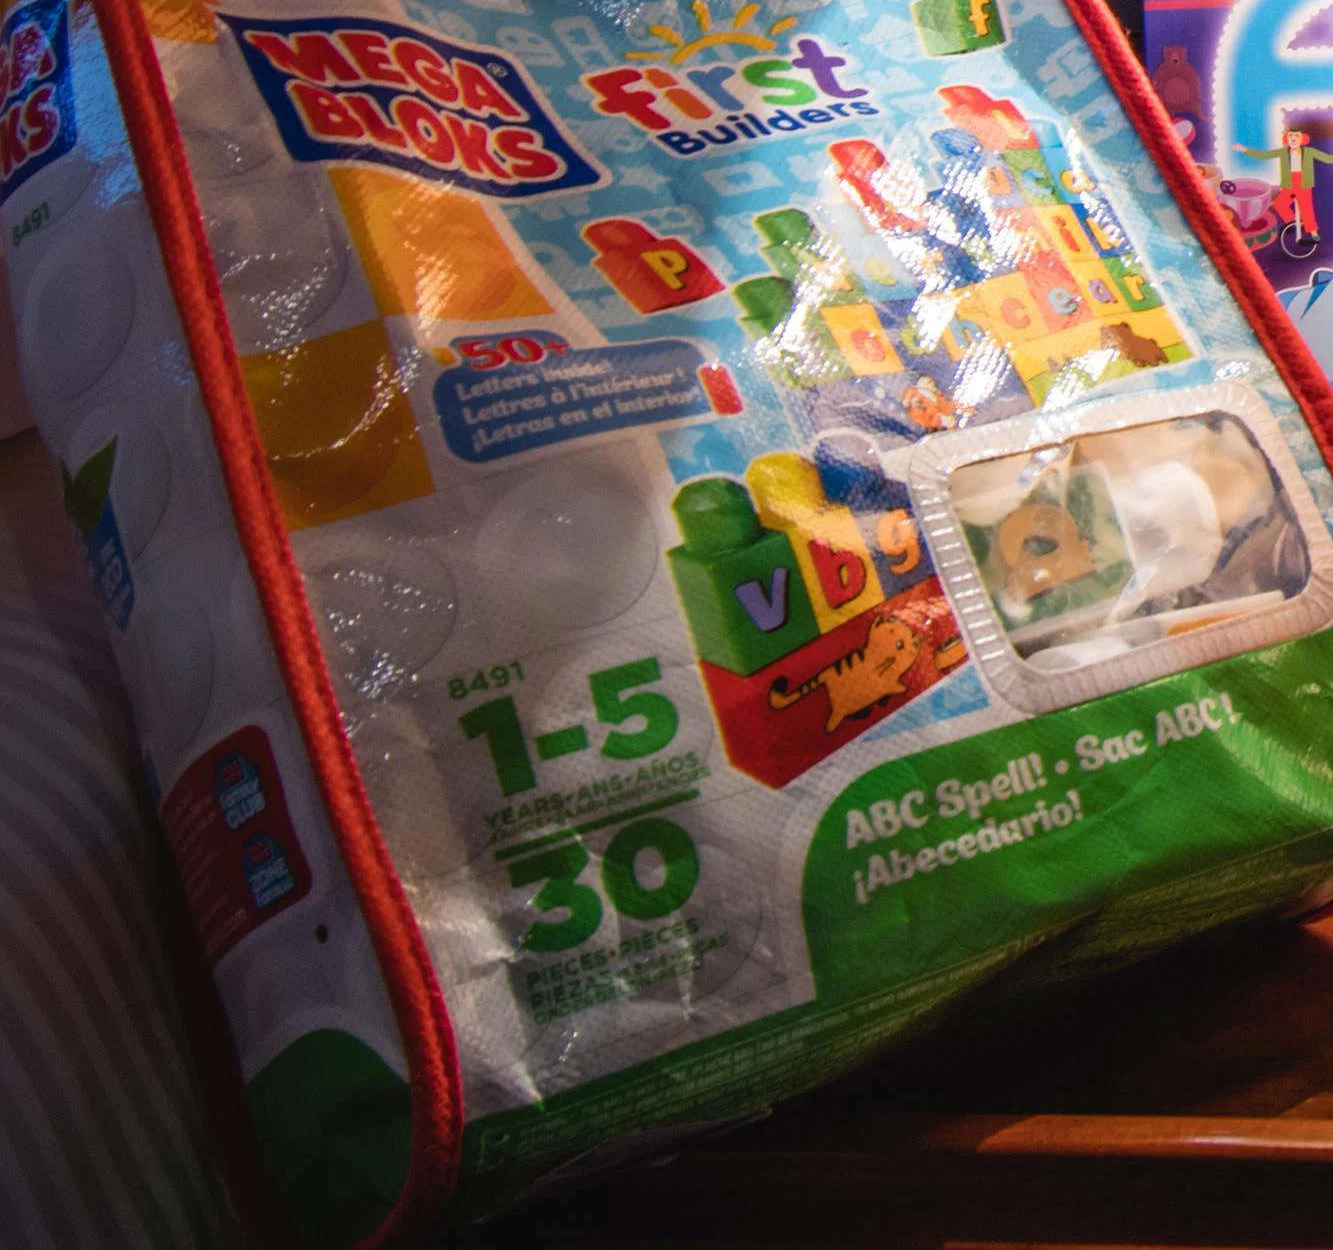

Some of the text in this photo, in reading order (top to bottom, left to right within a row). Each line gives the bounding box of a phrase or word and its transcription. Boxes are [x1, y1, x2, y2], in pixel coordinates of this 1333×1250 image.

[245, 30, 529, 122] MEGA
[287, 79, 567, 186] BLOKS
[656, 97, 879, 155] Builders
[455, 372, 539, 402] Letters
[457, 336, 569, 371] 50+
[462, 395, 547, 425] Lettres
[559, 409, 588, 427] en
[592, 402, 612, 421] el
[447, 661, 525, 700] 8491
[458, 656, 679, 798] 1-5
[845, 790, 929, 850] ABC
[935, 752, 1048, 820] Spell!
[1073, 733, 1148, 773] Sac
[852, 789, 1085, 906] ¡Abecedario!
[507, 817, 699, 954] 30
